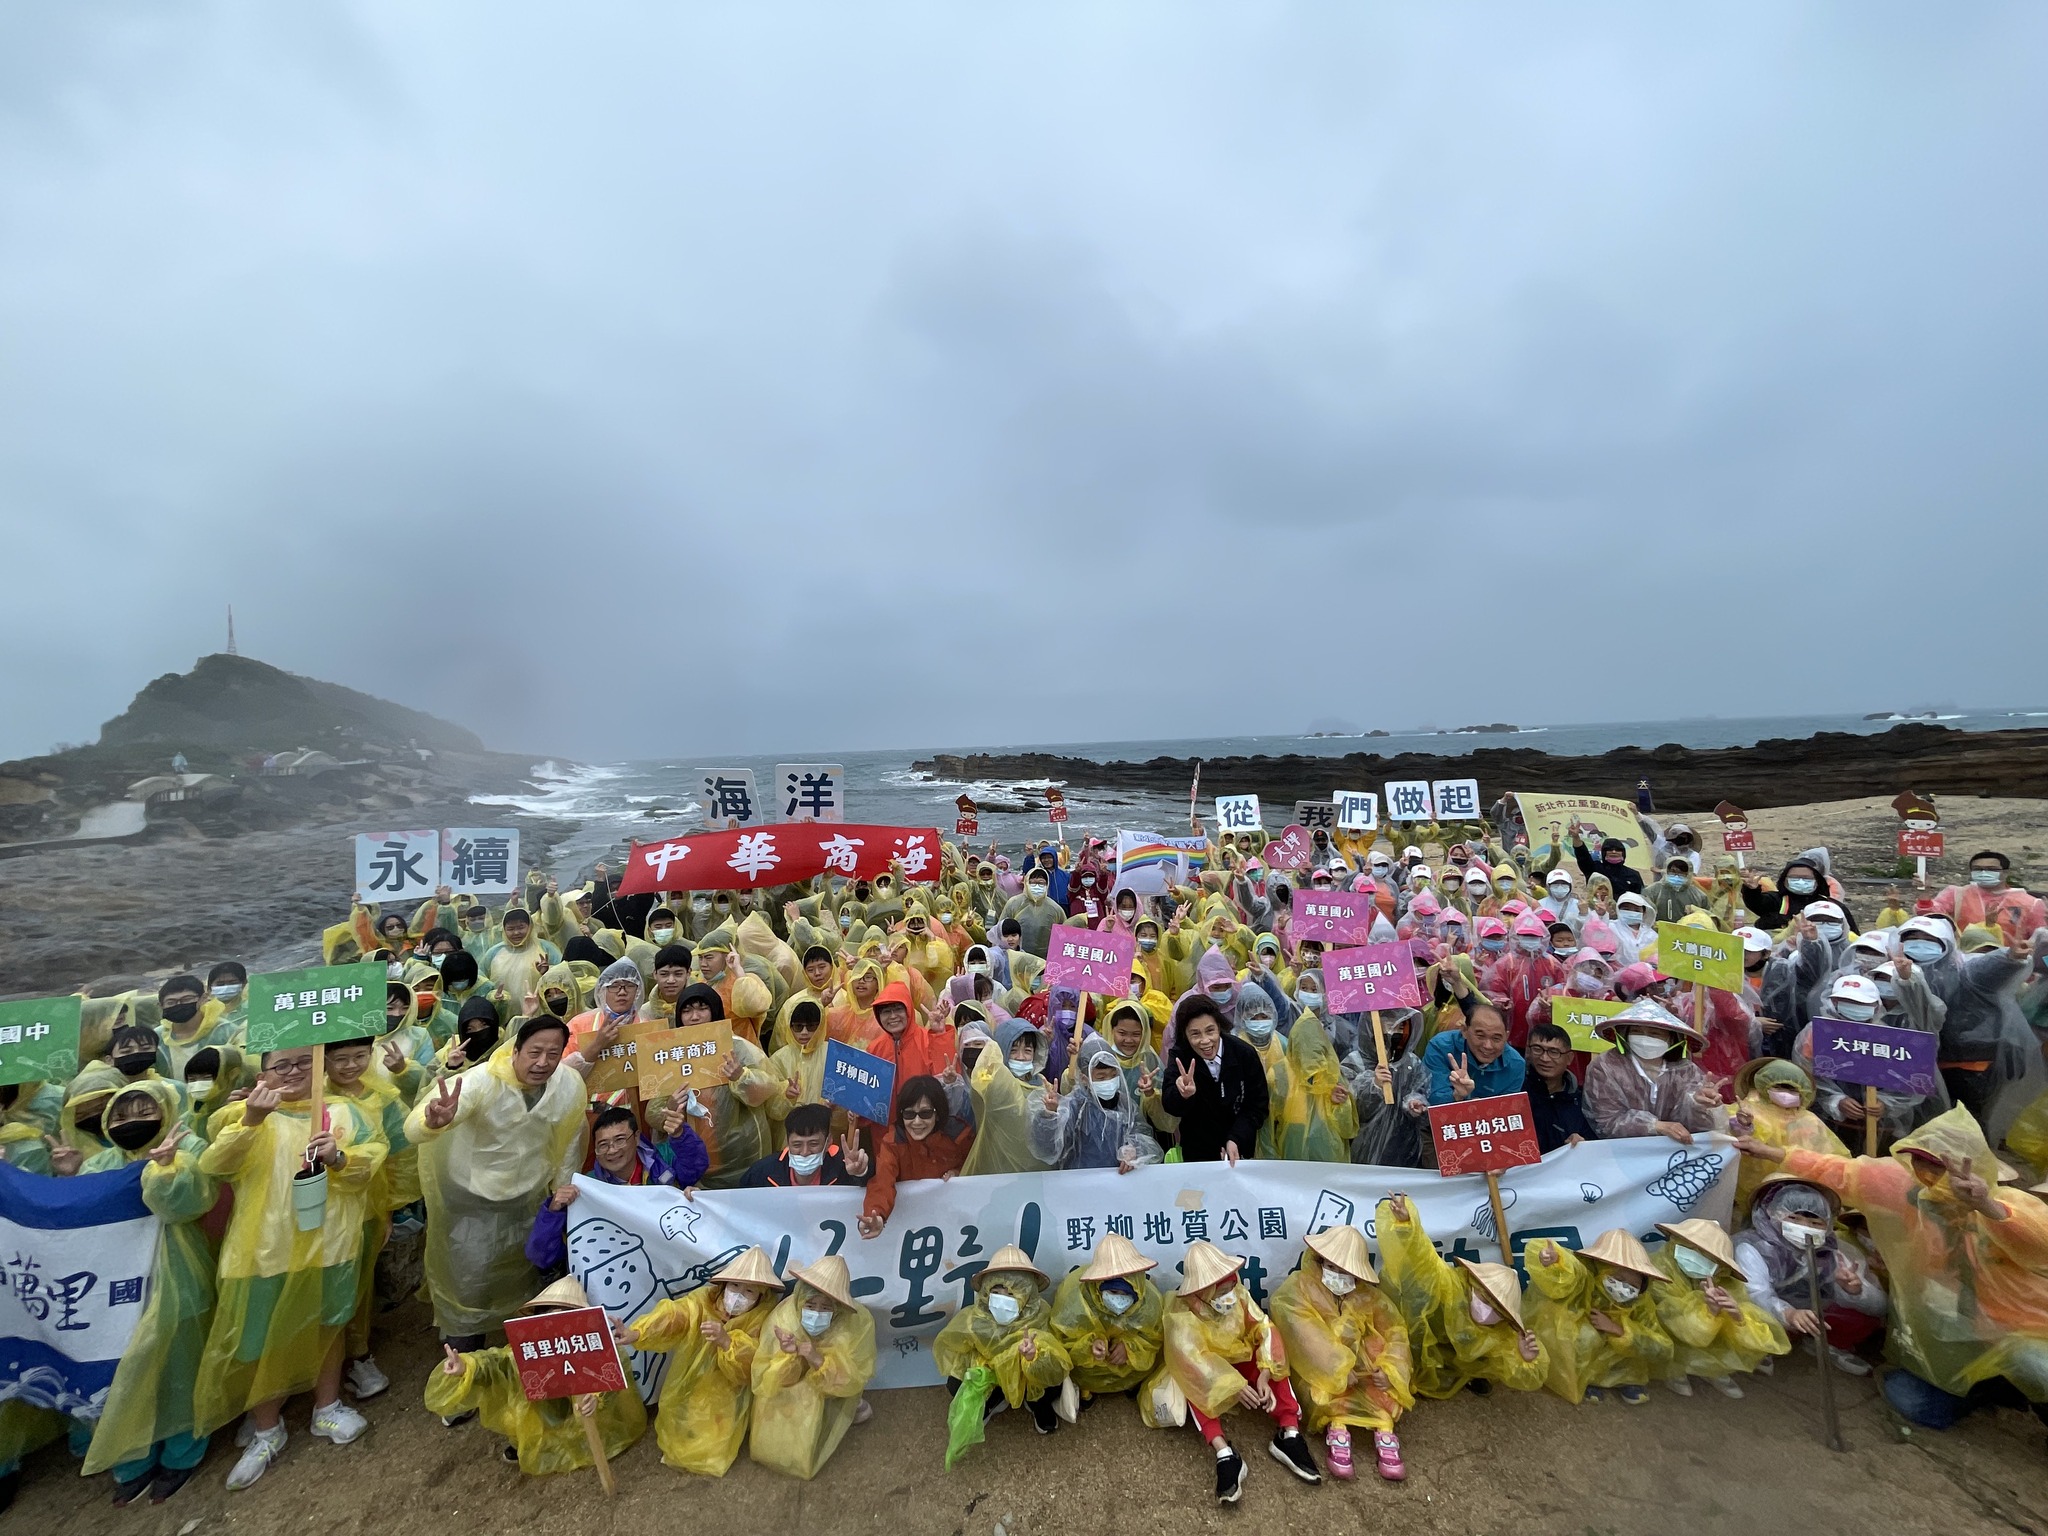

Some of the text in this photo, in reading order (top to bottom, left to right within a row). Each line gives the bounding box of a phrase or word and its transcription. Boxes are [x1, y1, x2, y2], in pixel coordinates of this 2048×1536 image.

[704, 776, 753, 822] 海
[785, 773, 835, 818] 洋
[1391, 786, 1426, 815] 做
[1440, 785, 1475, 815] 起
[1222, 799, 1255, 828] 從
[1299, 806, 1334, 828] 我
[1341, 796, 1372, 825] 們
[369, 841, 428, 892] 永
[453, 837, 508, 886] 續
[645, 833, 934, 881] 中華商海
[1305, 903, 1355, 919] 萬里國小
[1325, 921, 1334, 930] C
[1062, 942, 1118, 964] 萬里國小
[1671, 940, 1727, 961] 大鵬國小
[1082, 964, 1093, 976] A
[1338, 961, 1398, 983] 萬里國小
[1694, 959, 1703, 970] B
[273, 984, 363, 1012] 萬里國中
[1364, 981, 1376, 995] B
[312, 1011, 327, 1026] B
[0, 1022, 50, 1045] 國中
[1590, 1030, 1600, 1040] A
[654, 1041, 717, 1065] 中華商海
[1832, 1037, 1913, 1062] 大坪國小
[623, 1060, 634, 1073] A
[681, 1063, 693, 1077] B
[835, 1059, 881, 1089] 野柳國小
[1441, 1114, 1524, 1142] 萬里幼兒園
[1480, 1139, 1492, 1154] B
[1066, 1206, 1288, 1251] 野柳地質公園
[0, 1251, 151, 1332] 萬里國
[519, 1332, 604, 1361] 萬里幼兒園
[563, 1360, 576, 1376] A
